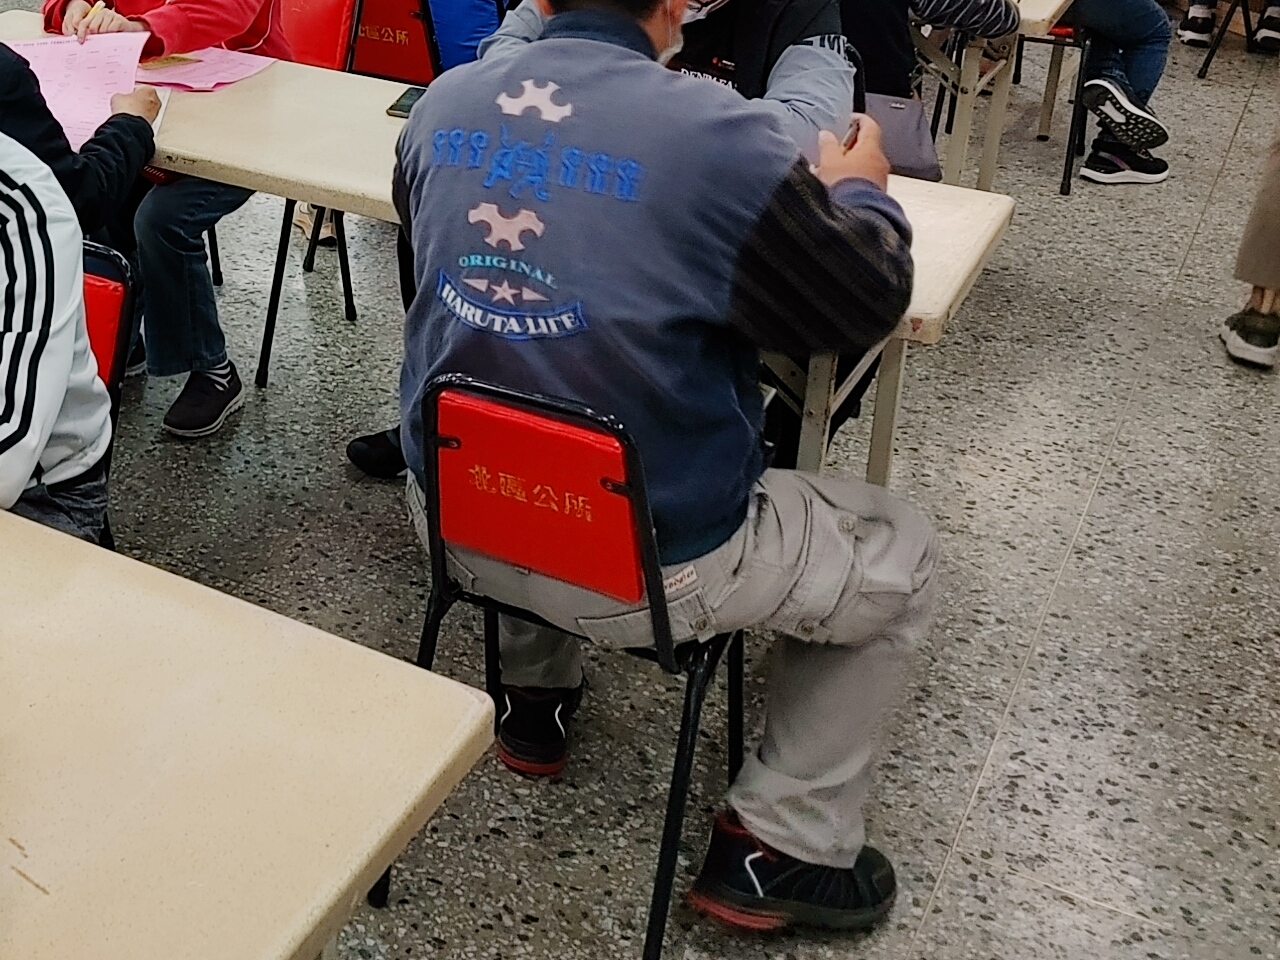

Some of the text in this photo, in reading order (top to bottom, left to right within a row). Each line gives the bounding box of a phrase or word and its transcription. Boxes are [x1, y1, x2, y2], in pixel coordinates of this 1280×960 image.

[458, 254, 558, 289] ORIGINAL
[441, 283, 520, 334] HARUTA
[468, 464, 594, 522] 北區公所
